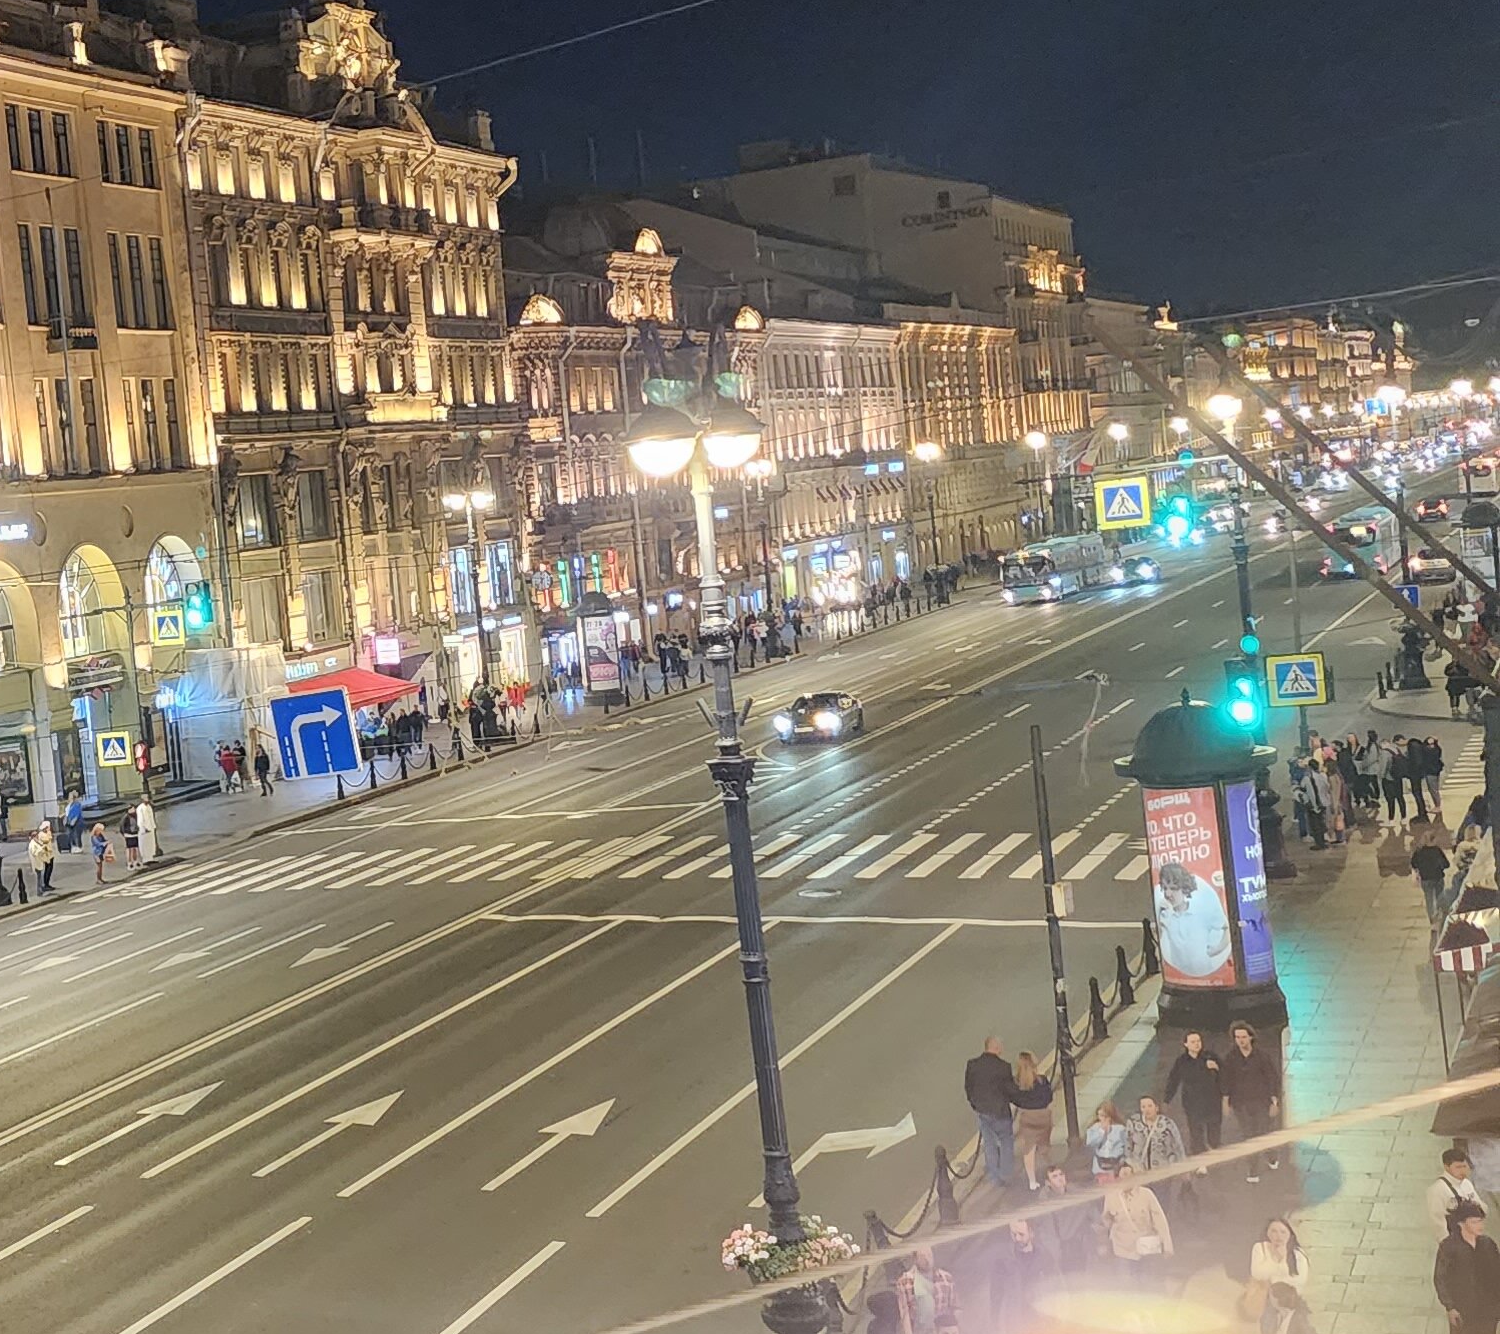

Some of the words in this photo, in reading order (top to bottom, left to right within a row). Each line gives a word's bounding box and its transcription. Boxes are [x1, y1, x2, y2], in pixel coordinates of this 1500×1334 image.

[1147, 791, 1192, 812] БОРЩ
[1162, 811, 1197, 832] ЧТО
[1150, 826, 1212, 854] ТЕПЕРЬ
